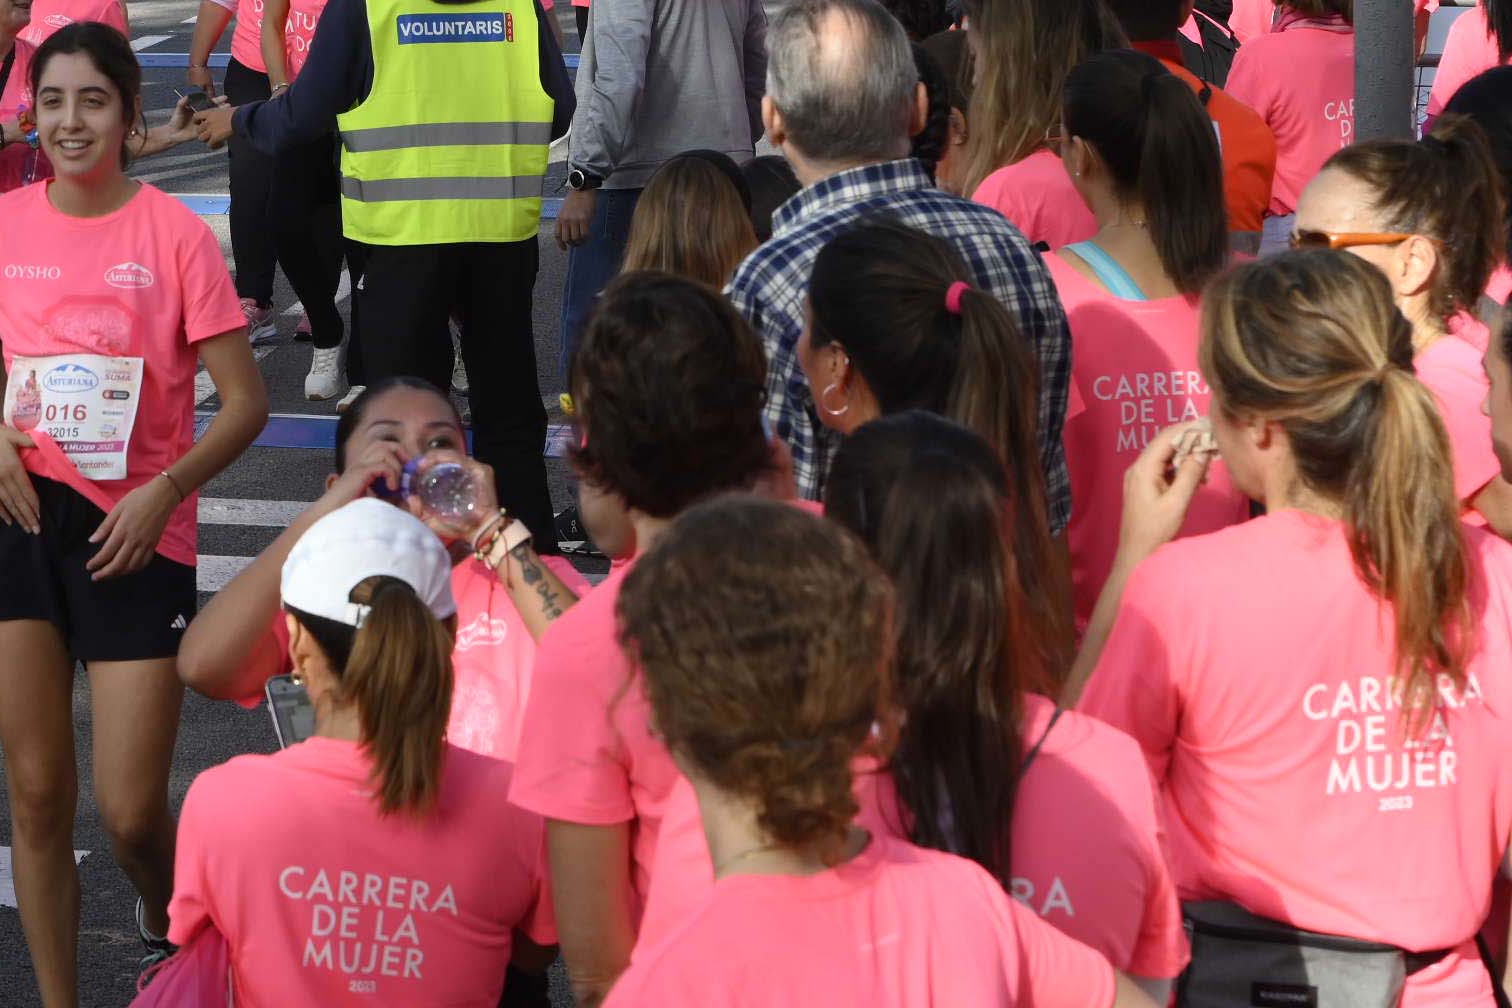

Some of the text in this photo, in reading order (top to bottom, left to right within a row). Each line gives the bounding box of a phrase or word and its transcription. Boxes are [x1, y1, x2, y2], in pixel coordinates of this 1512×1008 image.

[295, 11, 317, 30] TU
[399, 20, 503, 37] VOLUNTARIS
[4, 263, 62, 281] OYSHO
[45, 373, 94, 388] ASTURIANA
[45, 403, 88, 422] 016
[1120, 398, 1200, 425] DE LA
[71, 443, 97, 452] MUJER
[1336, 715, 1386, 755] DE
[1325, 750, 1457, 795] MUJER
[279, 866, 458, 916] CARRERA
[311, 903, 420, 946] DE LA
[302, 937, 425, 979] MUJER
